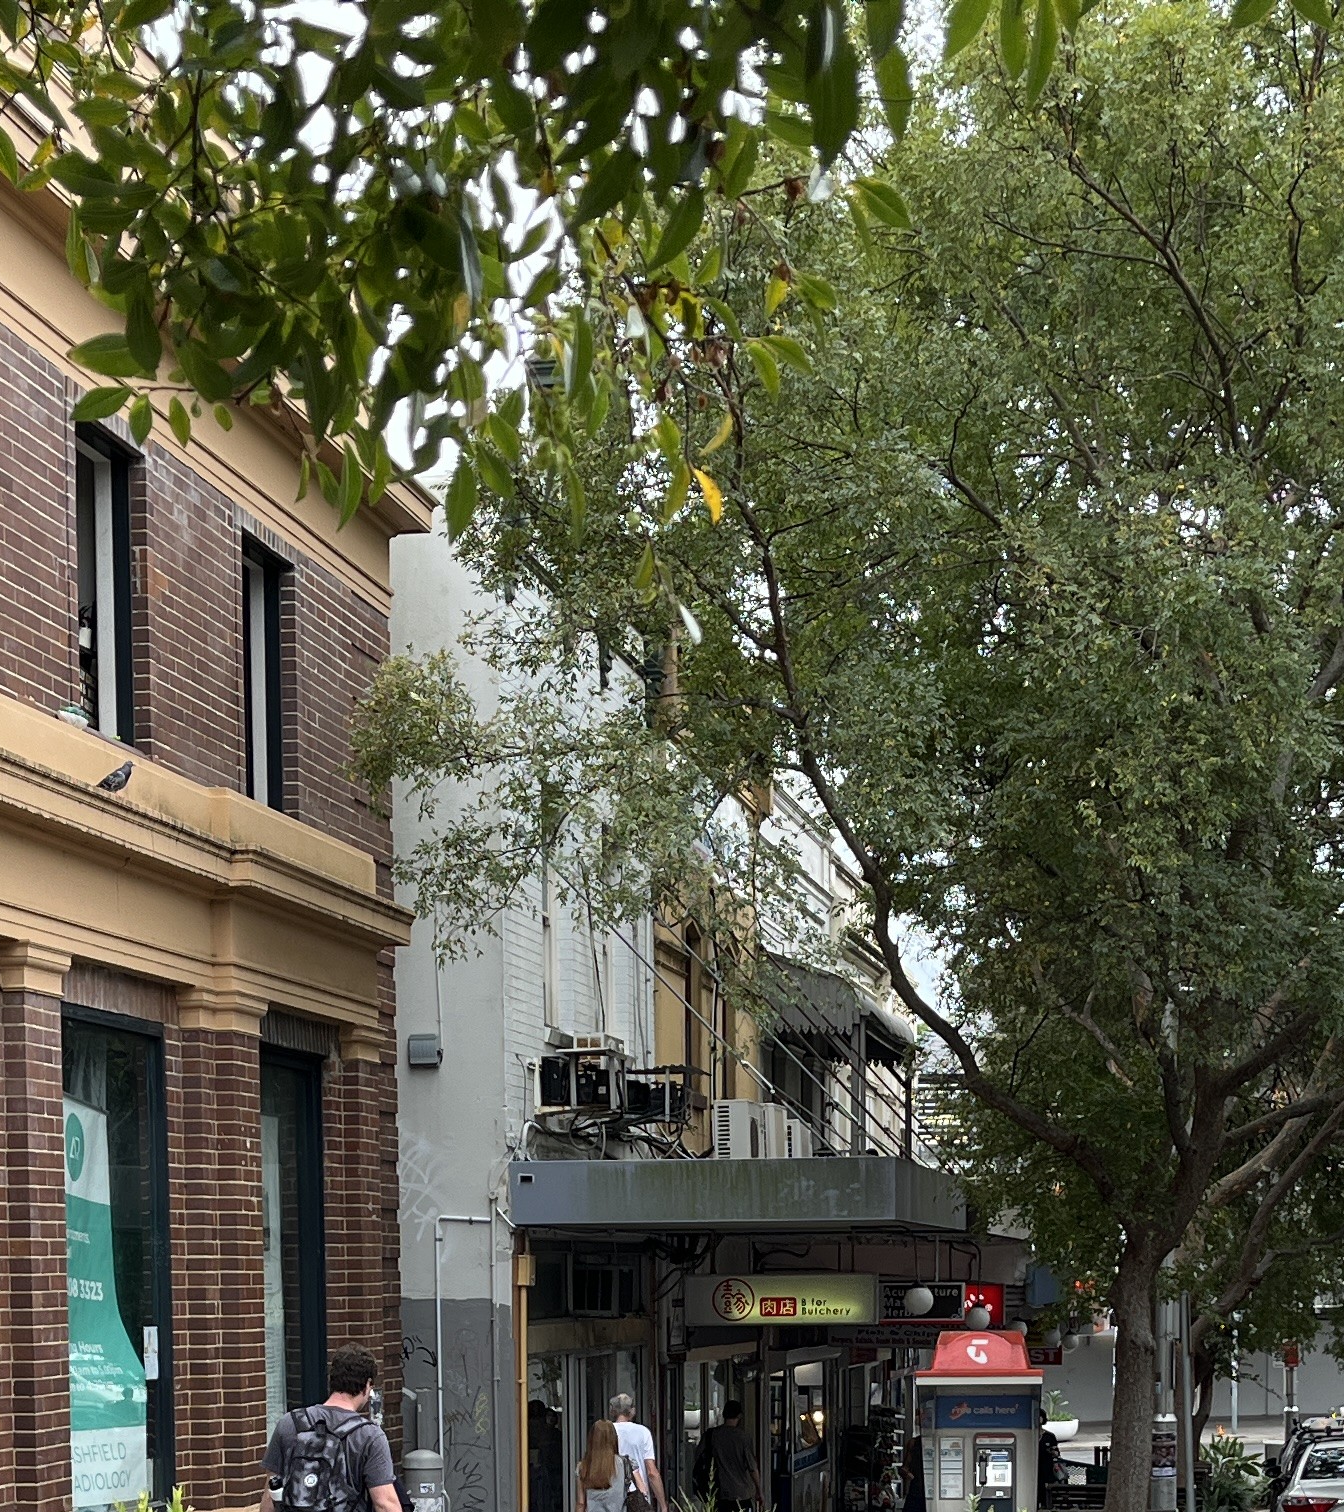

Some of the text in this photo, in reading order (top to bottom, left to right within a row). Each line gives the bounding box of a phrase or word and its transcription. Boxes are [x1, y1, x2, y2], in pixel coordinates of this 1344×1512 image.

[884, 1287, 959, 1297] Acuture
[760, 1298, 796, 1316] 肉店
[801, 1298, 827, 1307] B for
[801, 1306, 851, 1316] Butchery
[71, 1442, 127, 1464] SHFIELD
[74, 1469, 132, 1492] ADIOLOGY
